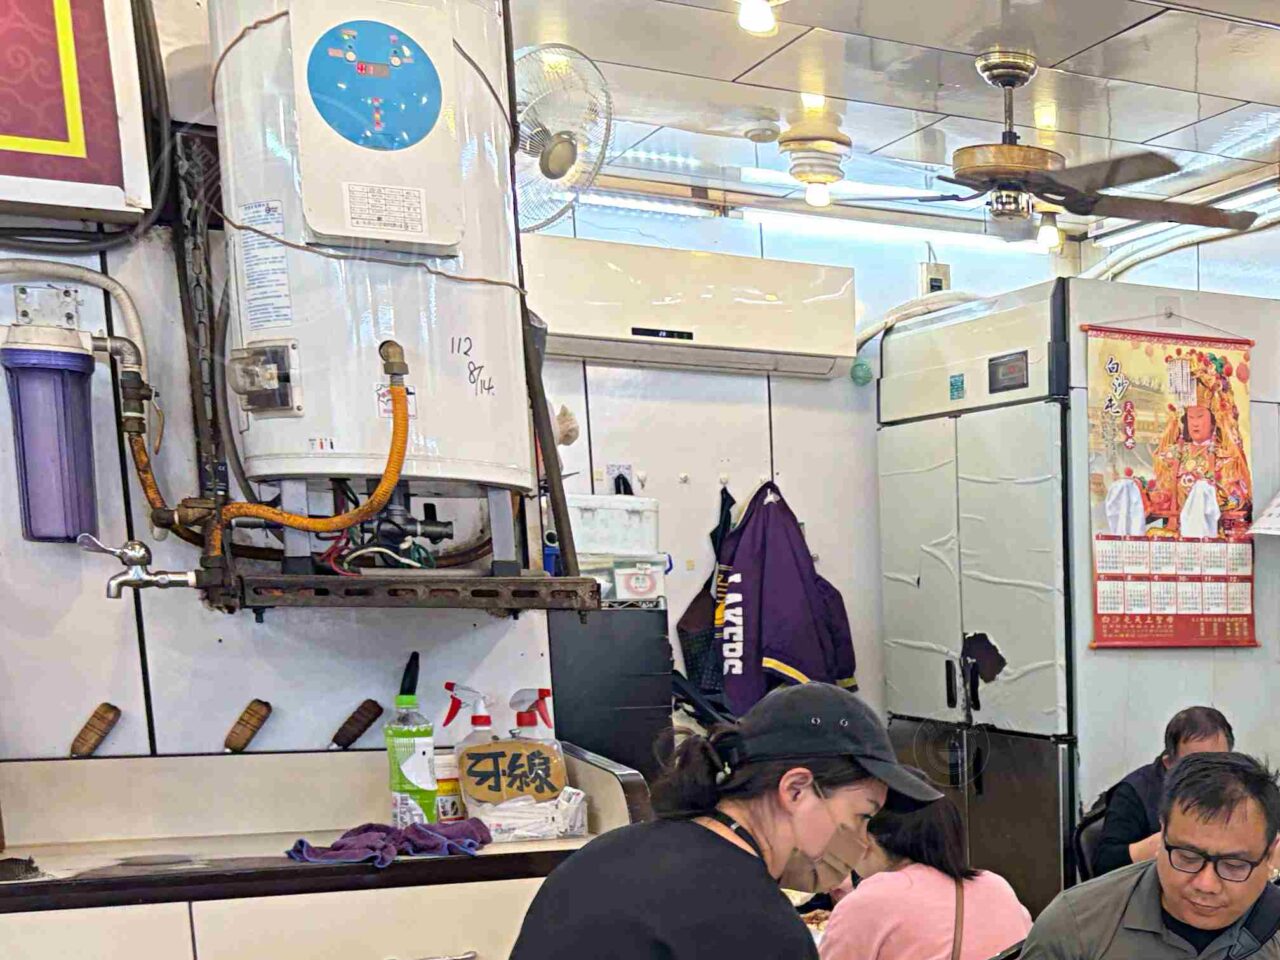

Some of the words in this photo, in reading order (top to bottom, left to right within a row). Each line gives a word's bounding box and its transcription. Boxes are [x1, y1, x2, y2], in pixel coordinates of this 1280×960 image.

[451, 336, 473, 357] 112
[1104, 357, 1129, 415] 白沙屯
[723, 573, 744, 675] KERS
[466, 750, 559, 793] 牙線
